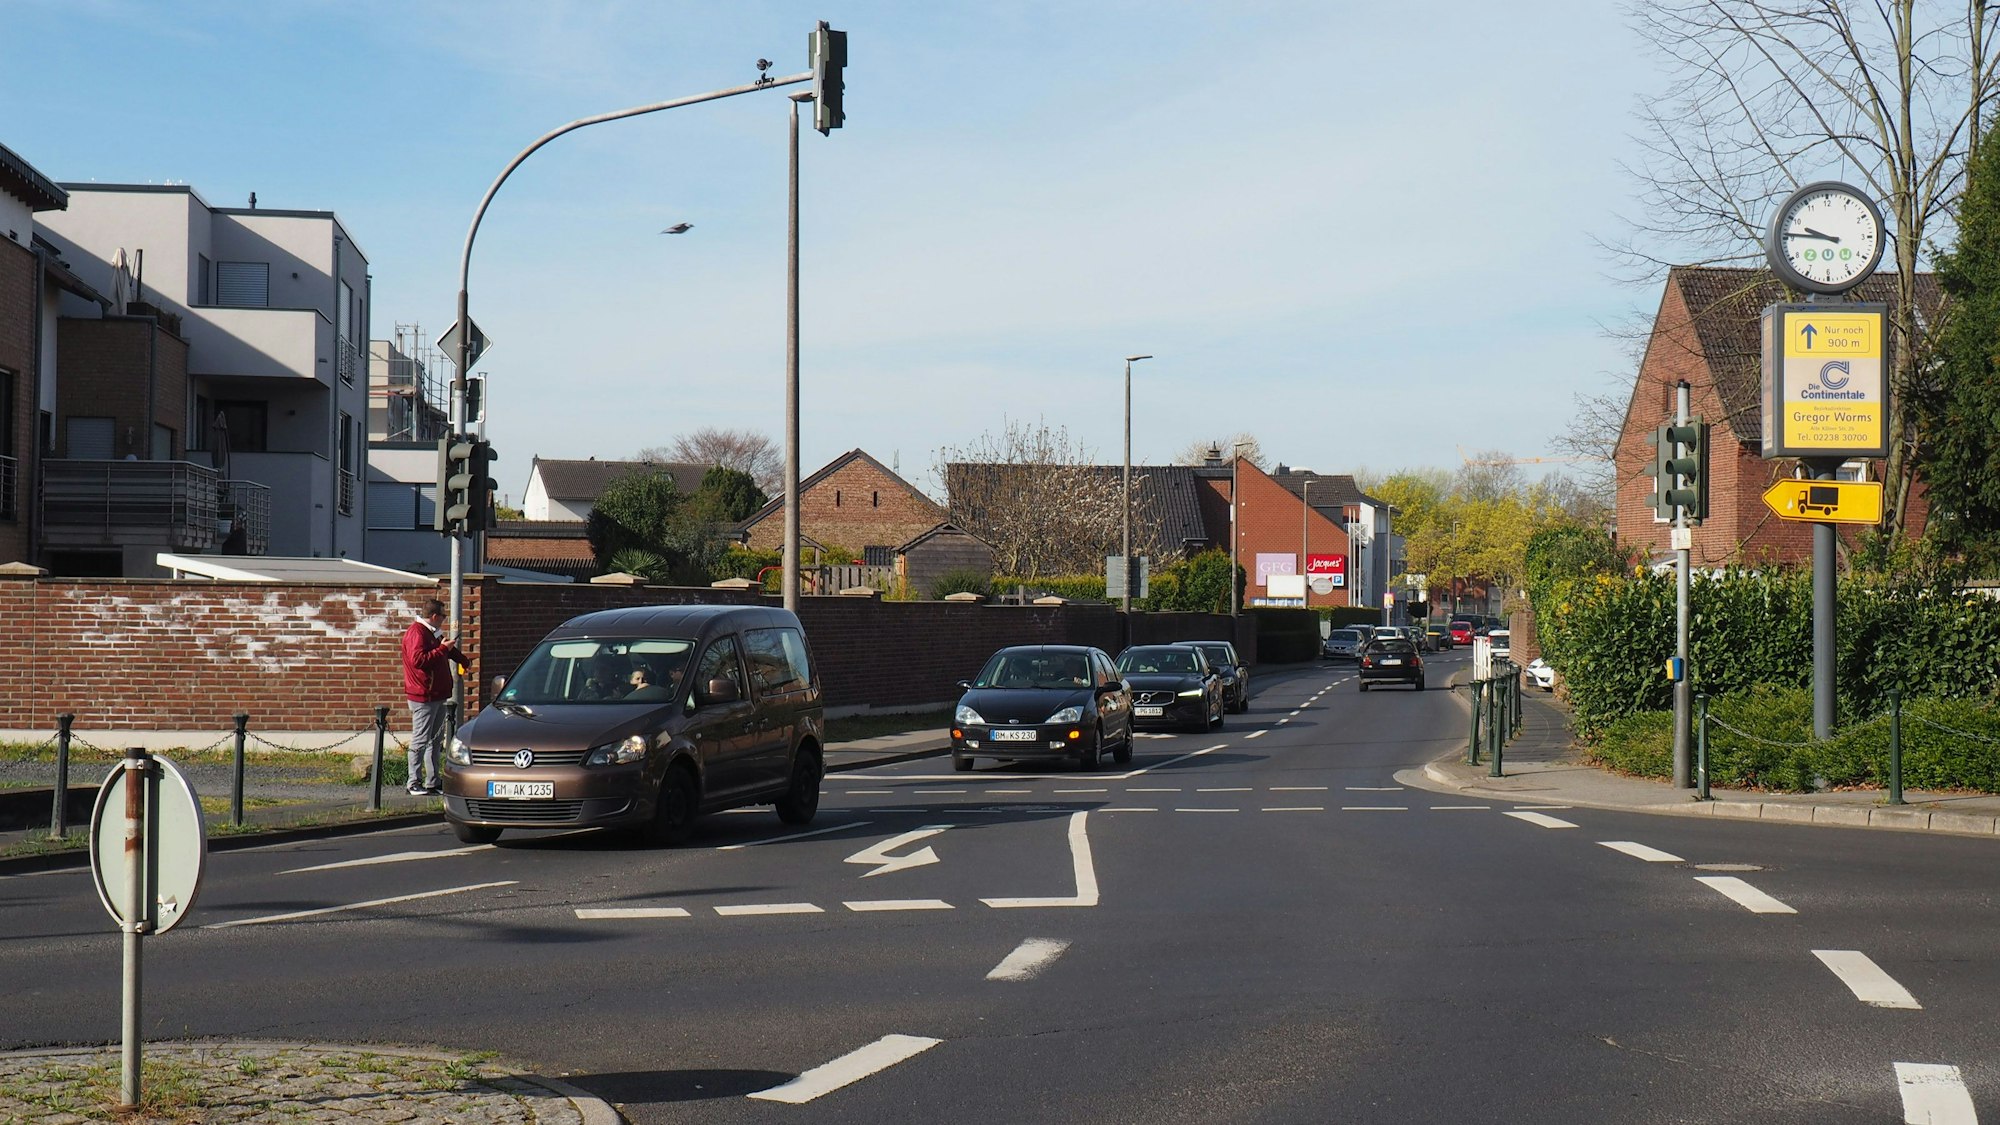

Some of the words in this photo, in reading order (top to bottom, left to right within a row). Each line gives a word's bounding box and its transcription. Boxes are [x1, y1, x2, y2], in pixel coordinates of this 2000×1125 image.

[1824, 326, 1840, 334] Nur
[1843, 326, 1864, 334] noch
[1828, 338, 1848, 347] 900
[1801, 389, 1865, 399] Continentale
[1793, 411, 1830, 424] Gregor
[1834, 412, 1872, 422] Worms
[1797, 433, 1811, 441] Tel.
[1814, 433, 1839, 441] 02238
[1842, 433, 1868, 442] 30700
[1260, 562, 1292, 573] GFG
[995, 730, 1006, 740] BM
[1010, 730, 1019, 740] KS
[1021, 730, 1036, 740] 230
[494, 784, 507, 795] GM
[513, 784, 525, 795] AK
[528, 784, 552, 796] 1235
